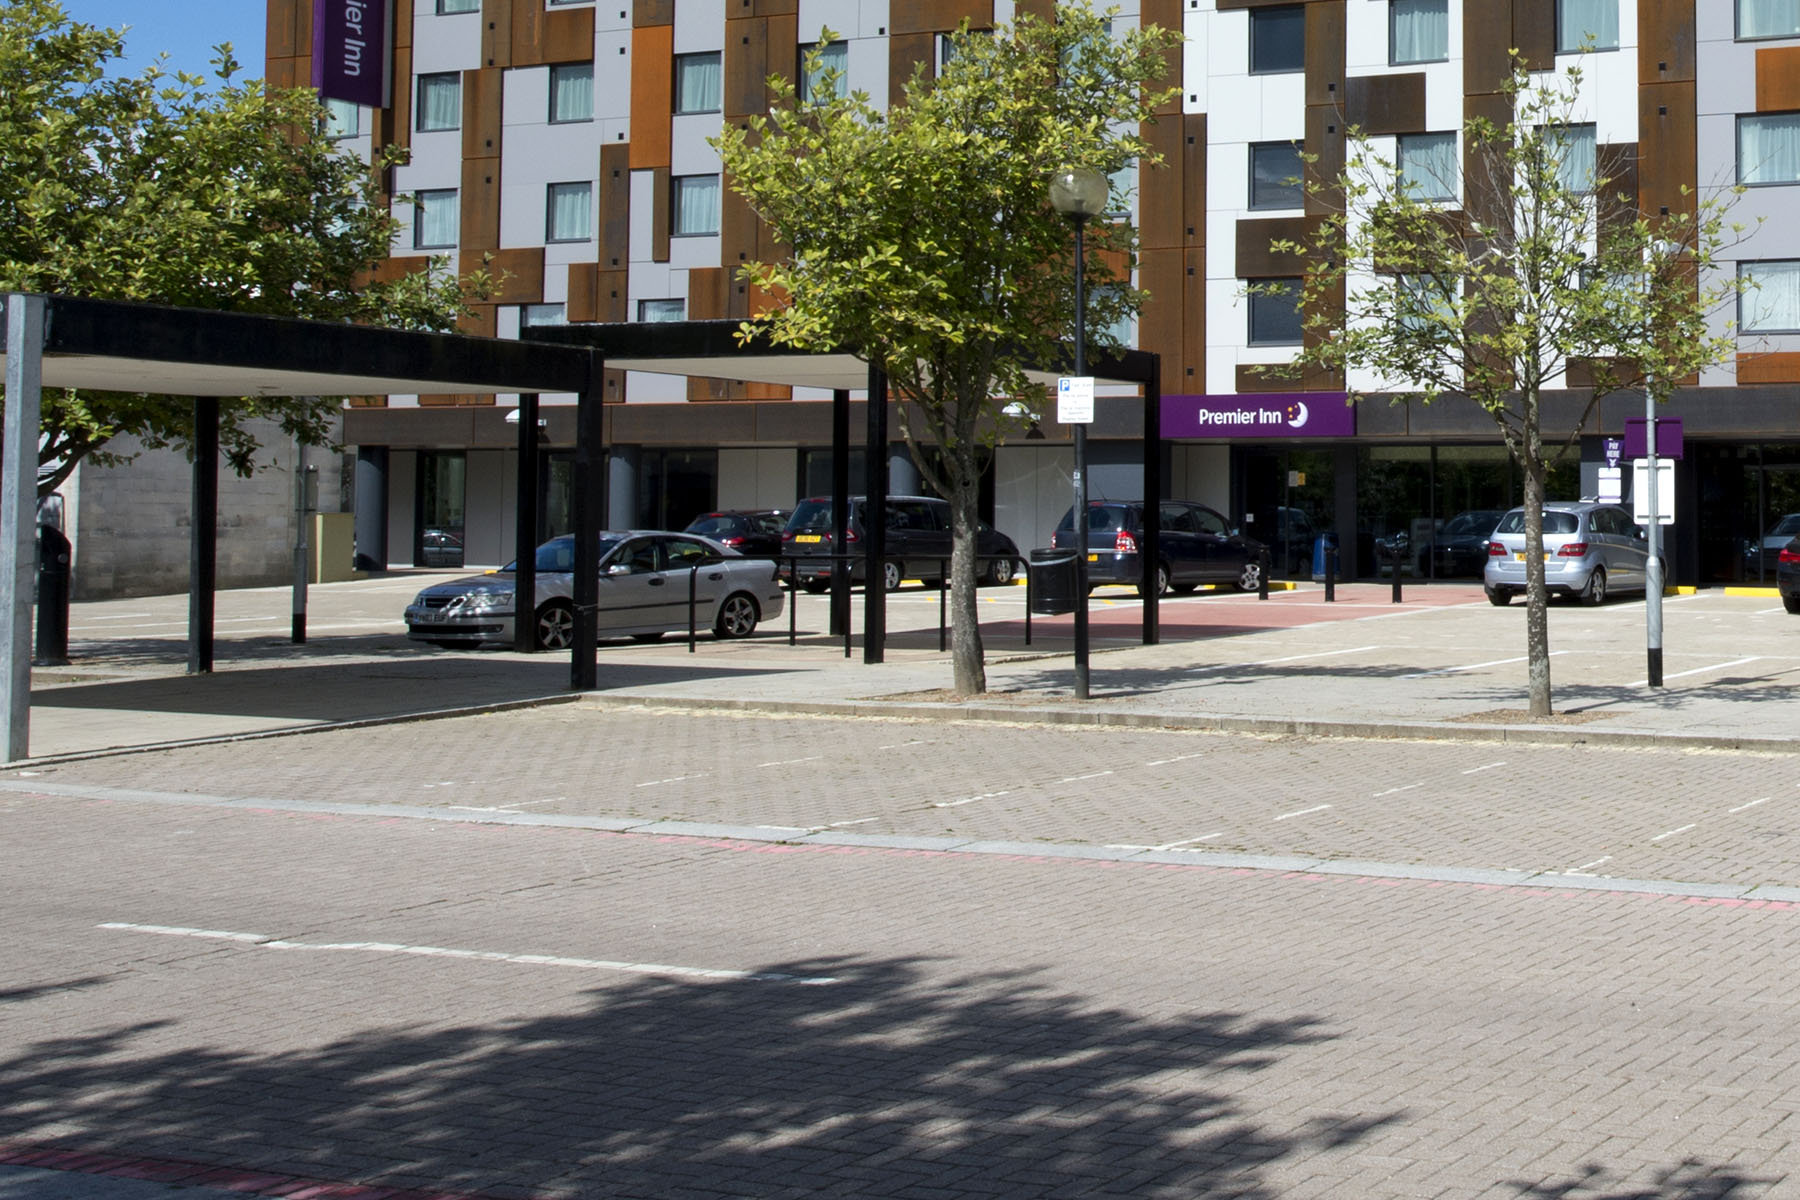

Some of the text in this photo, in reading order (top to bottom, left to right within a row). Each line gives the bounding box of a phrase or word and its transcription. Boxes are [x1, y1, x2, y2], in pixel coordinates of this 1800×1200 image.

[343, 37, 366, 76] Inn
[1199, 407, 1282, 425] Premier Inn
[1608, 442, 1620, 450] PAY
[1606, 450, 1620, 458] HERE
